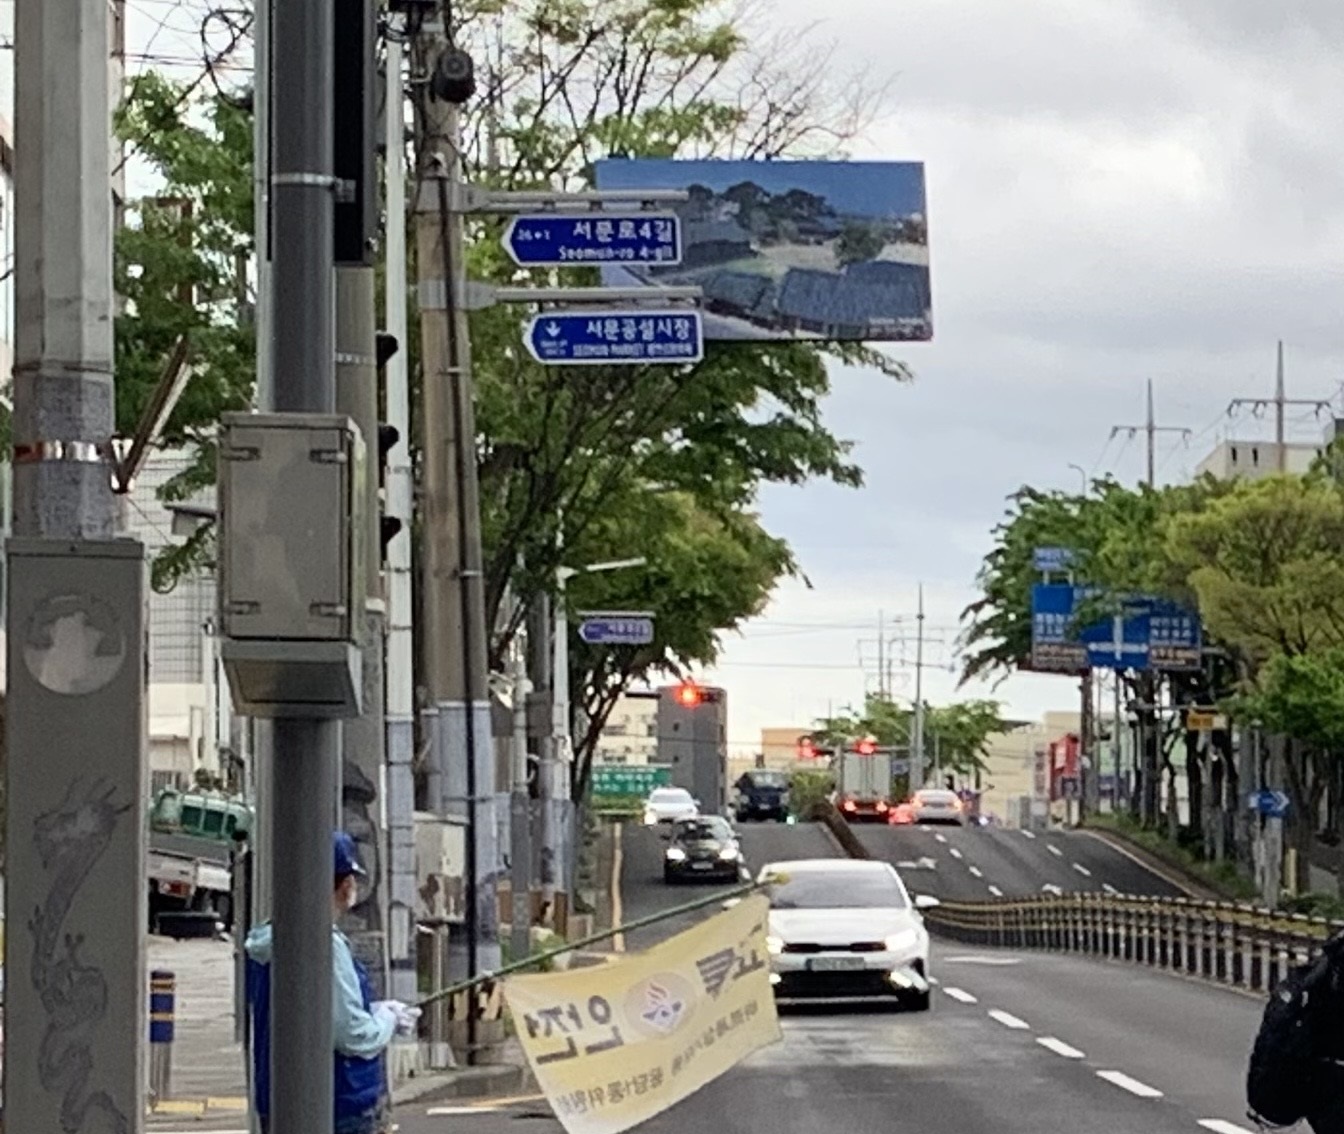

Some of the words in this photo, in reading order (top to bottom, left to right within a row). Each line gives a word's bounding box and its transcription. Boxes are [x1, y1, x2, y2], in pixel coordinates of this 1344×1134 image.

[573, 220, 672, 243] 서문로4길
[558, 245, 635, 260] Seomun-ro
[586, 318, 690, 341] 서문공설시장
